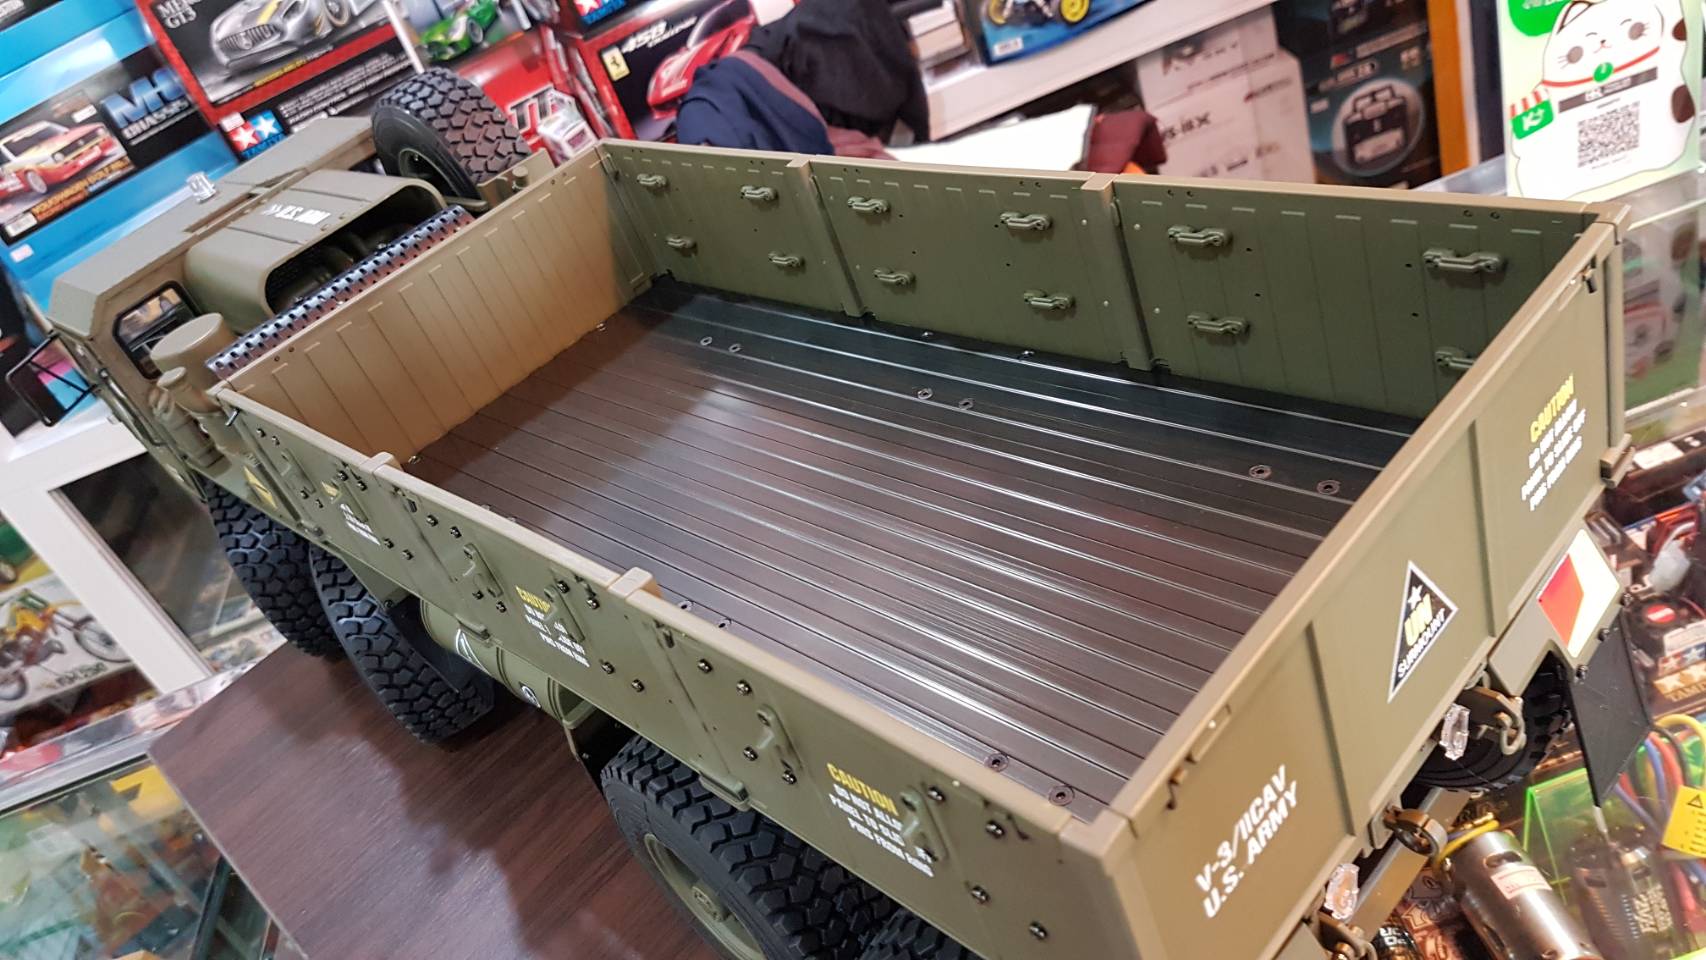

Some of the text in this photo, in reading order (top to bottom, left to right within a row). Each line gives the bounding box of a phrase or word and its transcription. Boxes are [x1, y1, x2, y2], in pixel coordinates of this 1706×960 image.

[165, 7, 197, 28] GT3
[826, 762, 899, 817] CAUTION
[1203, 780, 1297, 918] U.S. ARMY
